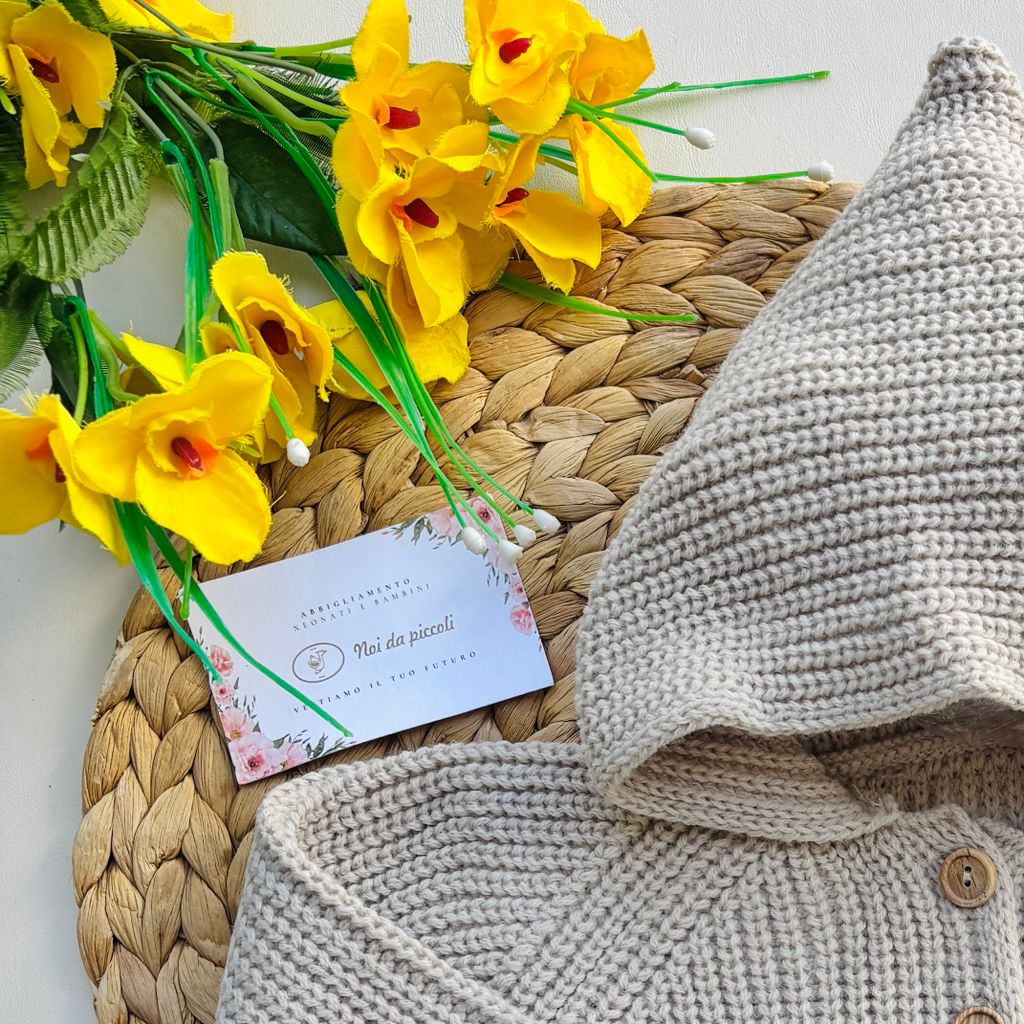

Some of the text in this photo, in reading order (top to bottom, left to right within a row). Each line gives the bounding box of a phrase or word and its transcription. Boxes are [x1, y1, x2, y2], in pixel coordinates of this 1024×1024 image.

[293, 607, 352, 631] NEONATI
[374, 583, 430, 606] BAMBINI
[301, 578, 410, 618] ABBIGLIAMENTO
[353, 614, 455, 659] Noi da piccoli
[293, 651, 476, 713] VETIAMO IL TUO FUTURO
